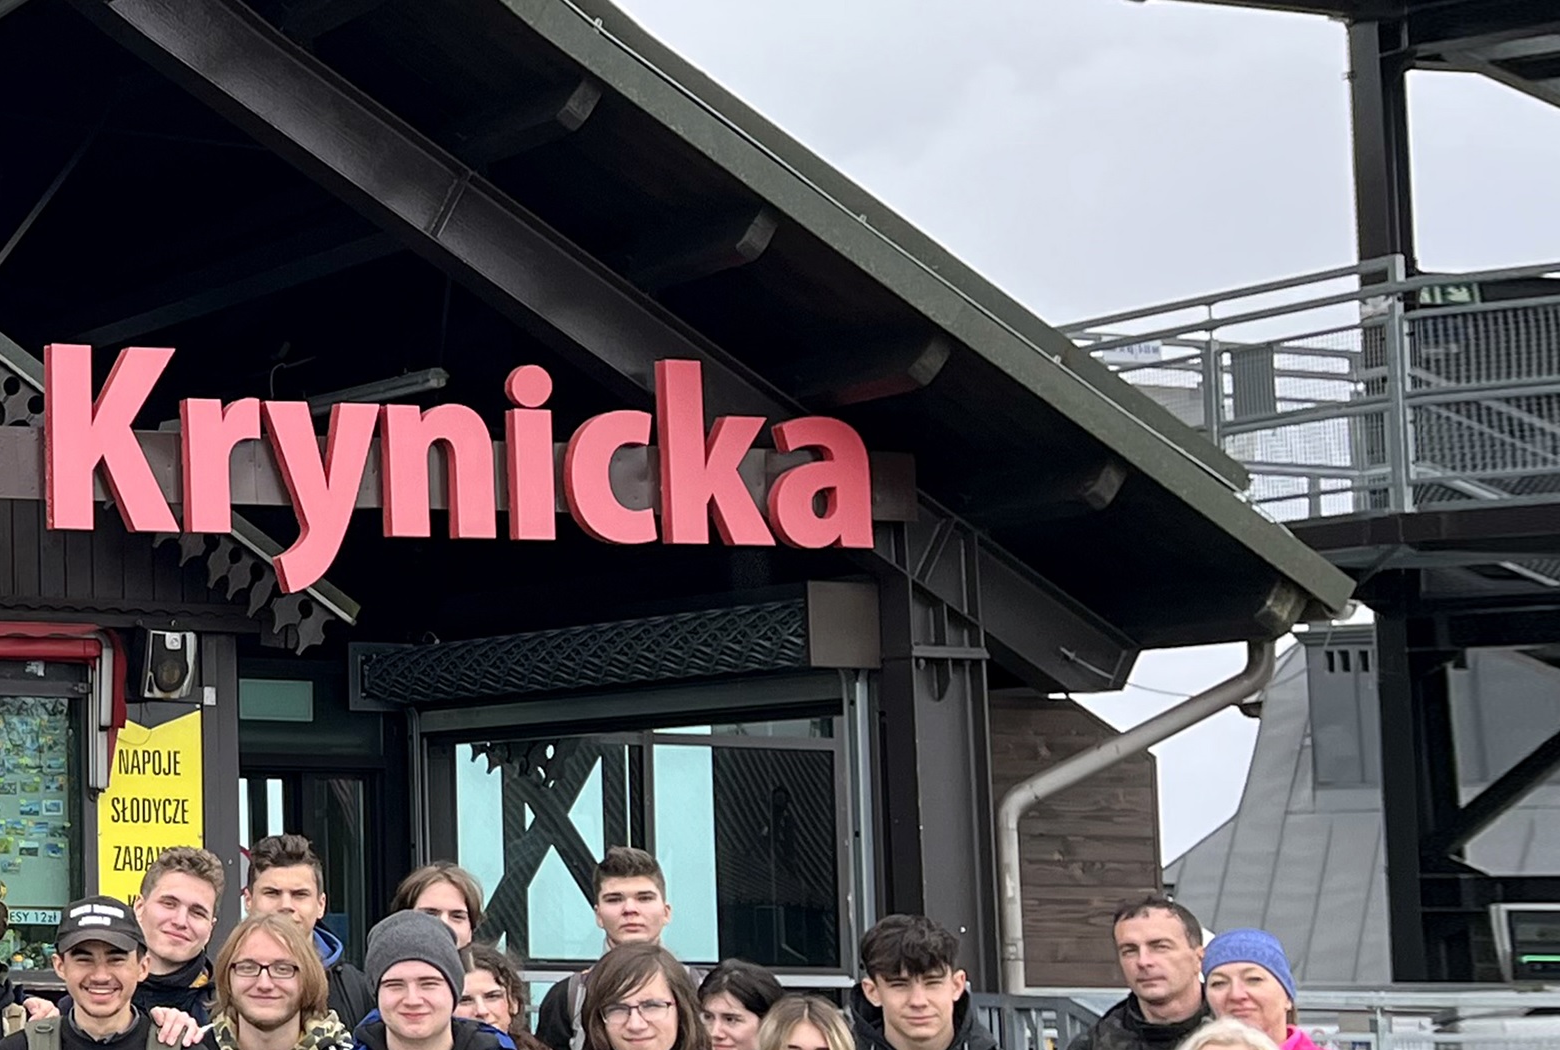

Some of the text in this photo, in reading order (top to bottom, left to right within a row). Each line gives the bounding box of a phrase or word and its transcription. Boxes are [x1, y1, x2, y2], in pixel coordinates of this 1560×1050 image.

[44, 343, 876, 594] Krynicka
[118, 749, 181, 776] NAPOJE
[111, 797, 189, 824] SŁODYCZE
[9, 911, 29, 922] ESY
